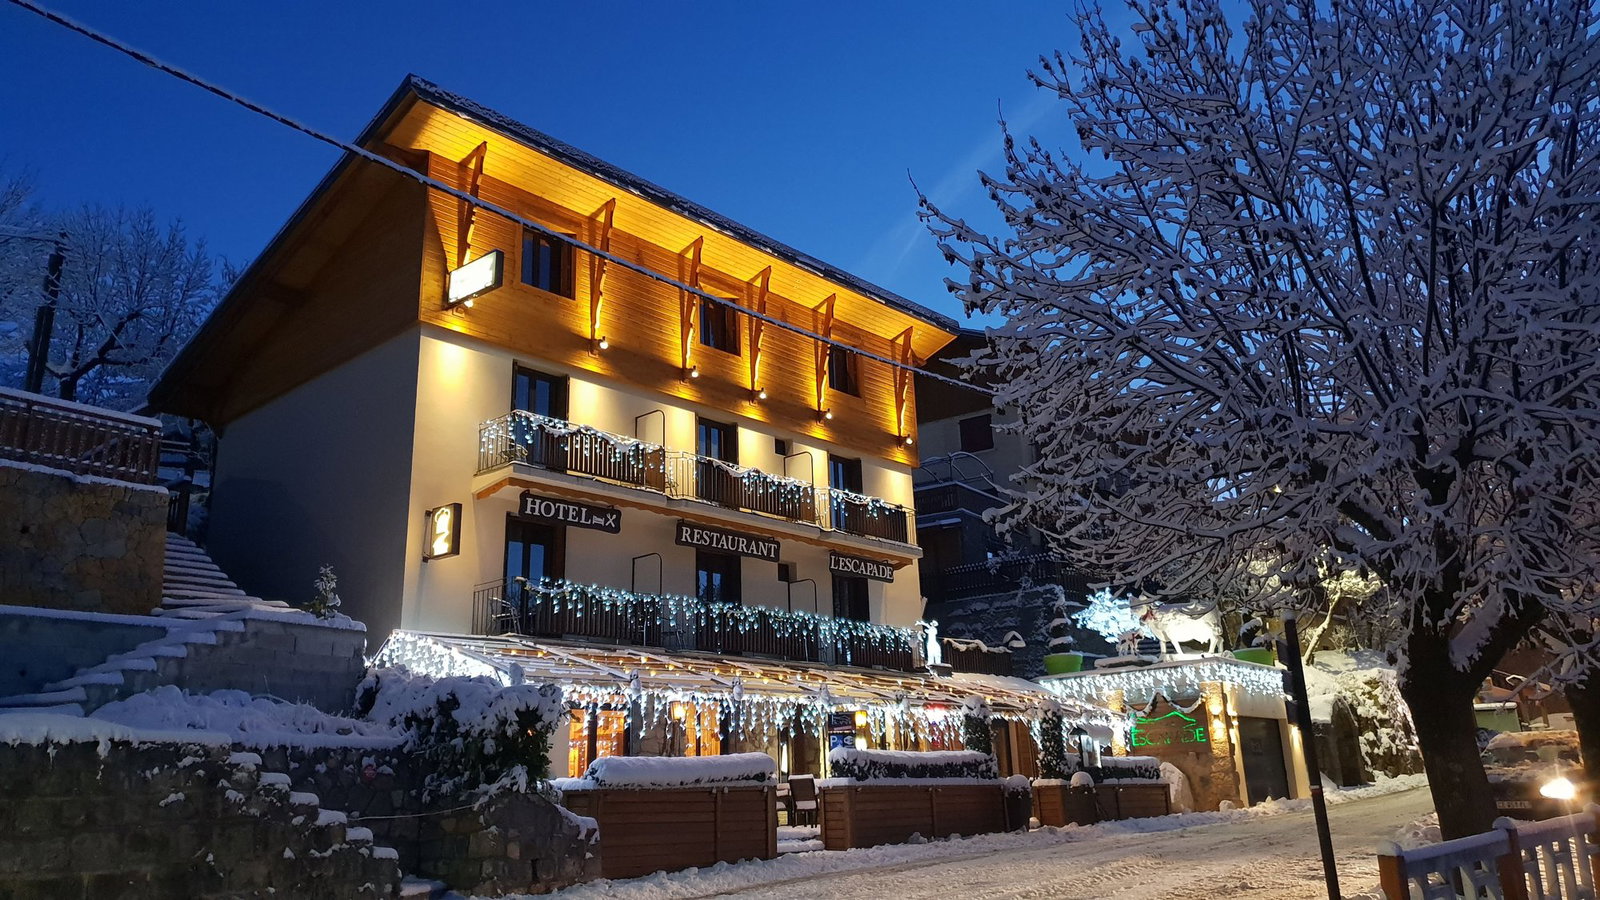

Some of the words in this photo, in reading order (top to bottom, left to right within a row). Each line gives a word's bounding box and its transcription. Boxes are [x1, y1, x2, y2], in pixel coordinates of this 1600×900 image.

[525, 497, 592, 525] HOTEL
[681, 526, 778, 558] RESTAURANT
[830, 555, 894, 580] L'ESCAPADE
